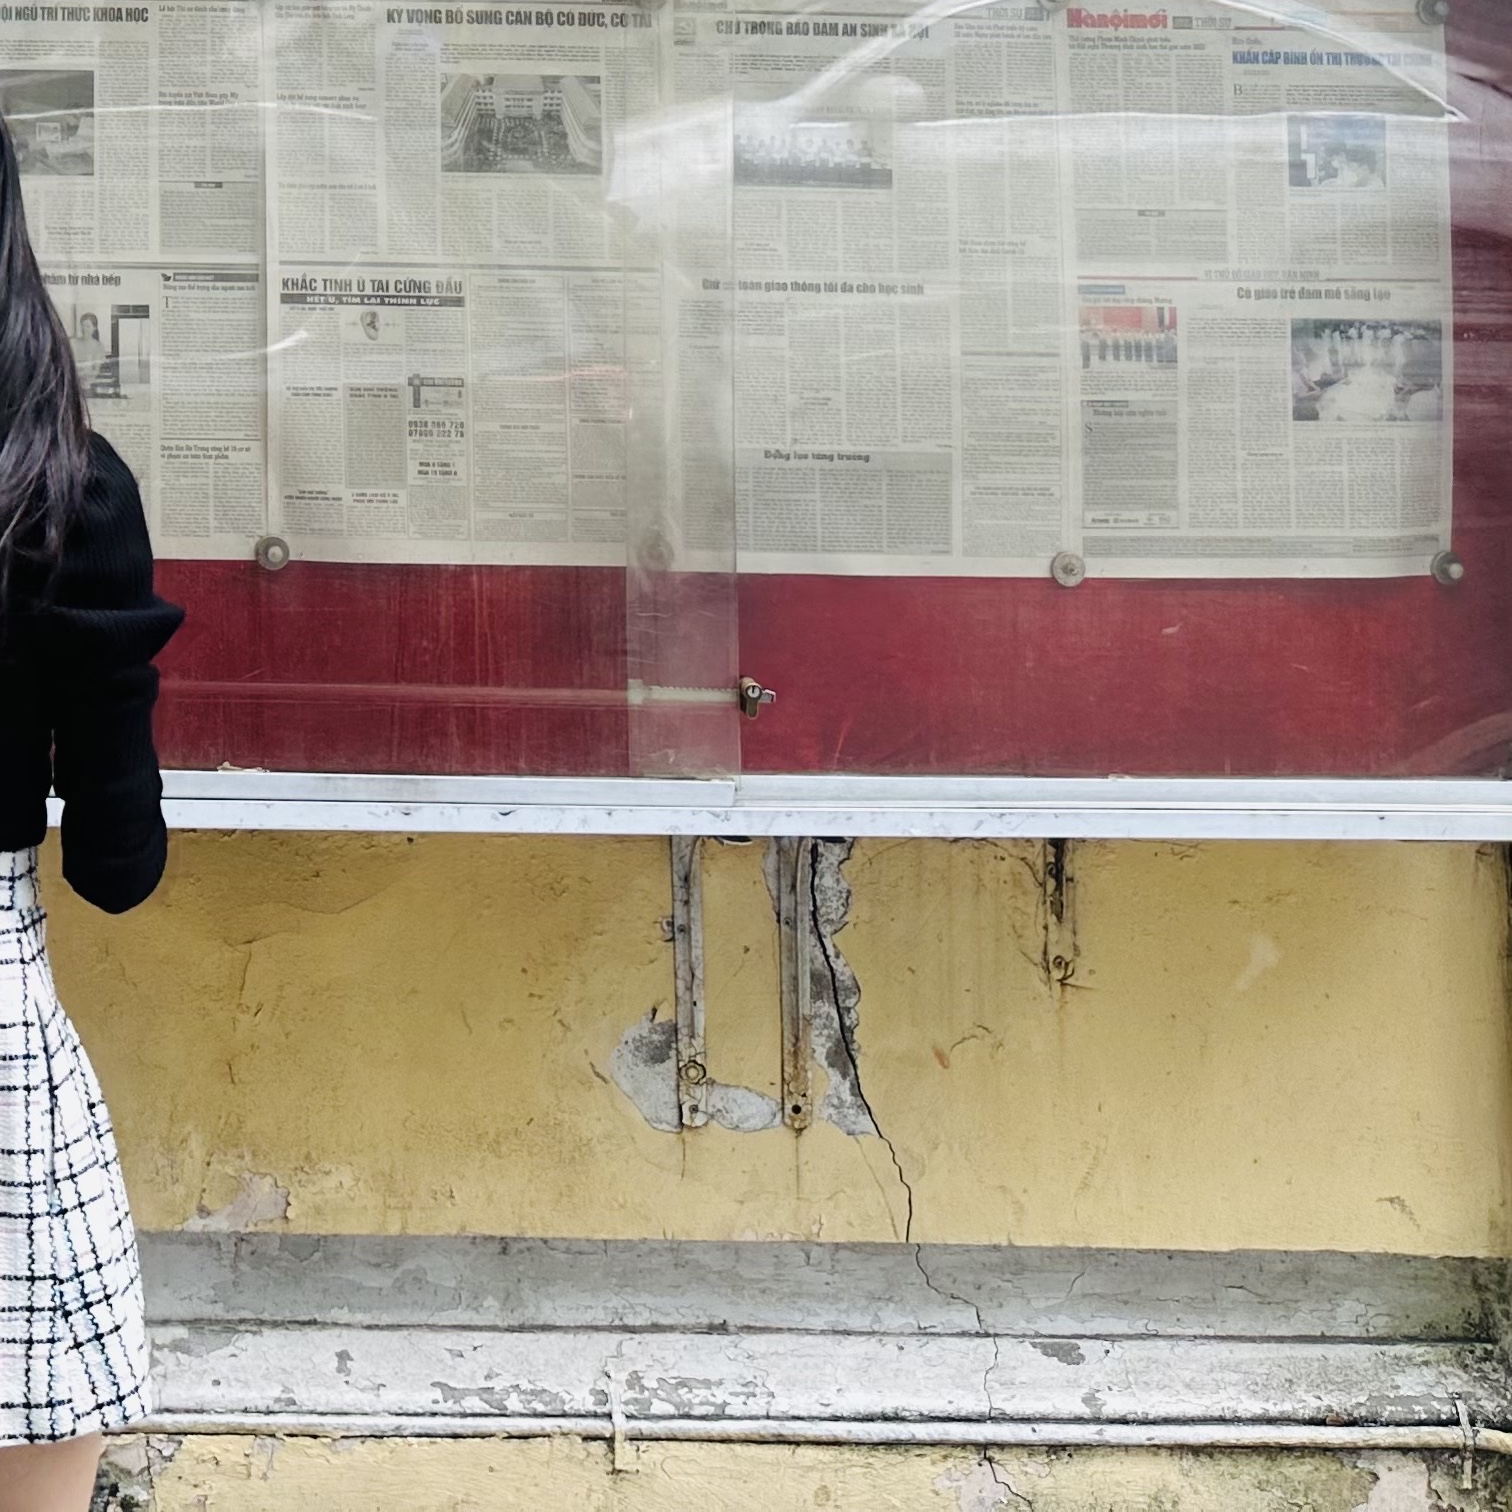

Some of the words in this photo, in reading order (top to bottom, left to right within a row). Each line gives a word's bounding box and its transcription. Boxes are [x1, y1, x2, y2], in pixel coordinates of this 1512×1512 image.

[93, 7, 123, 22] KHOA
[126, 7, 149, 24] HỌC
[406, 8, 442, 27] VỌNG
[445, 5, 463, 24] BỔ
[466, 9, 502, 26] SUNG
[506, 7, 532, 26] CÁN
[535, 8, 553, 28] BỘ
[557, 8, 575, 27] CÓ
[842, 22, 857, 36] AN
[281, 272, 318, 292] KHẮC
[322, 278, 352, 293] TINH
[370, 278, 389, 293] TAI
[764, 281, 788, 292] giao
[856, 282, 876, 294] cho
[900, 283, 924, 295] sinh
